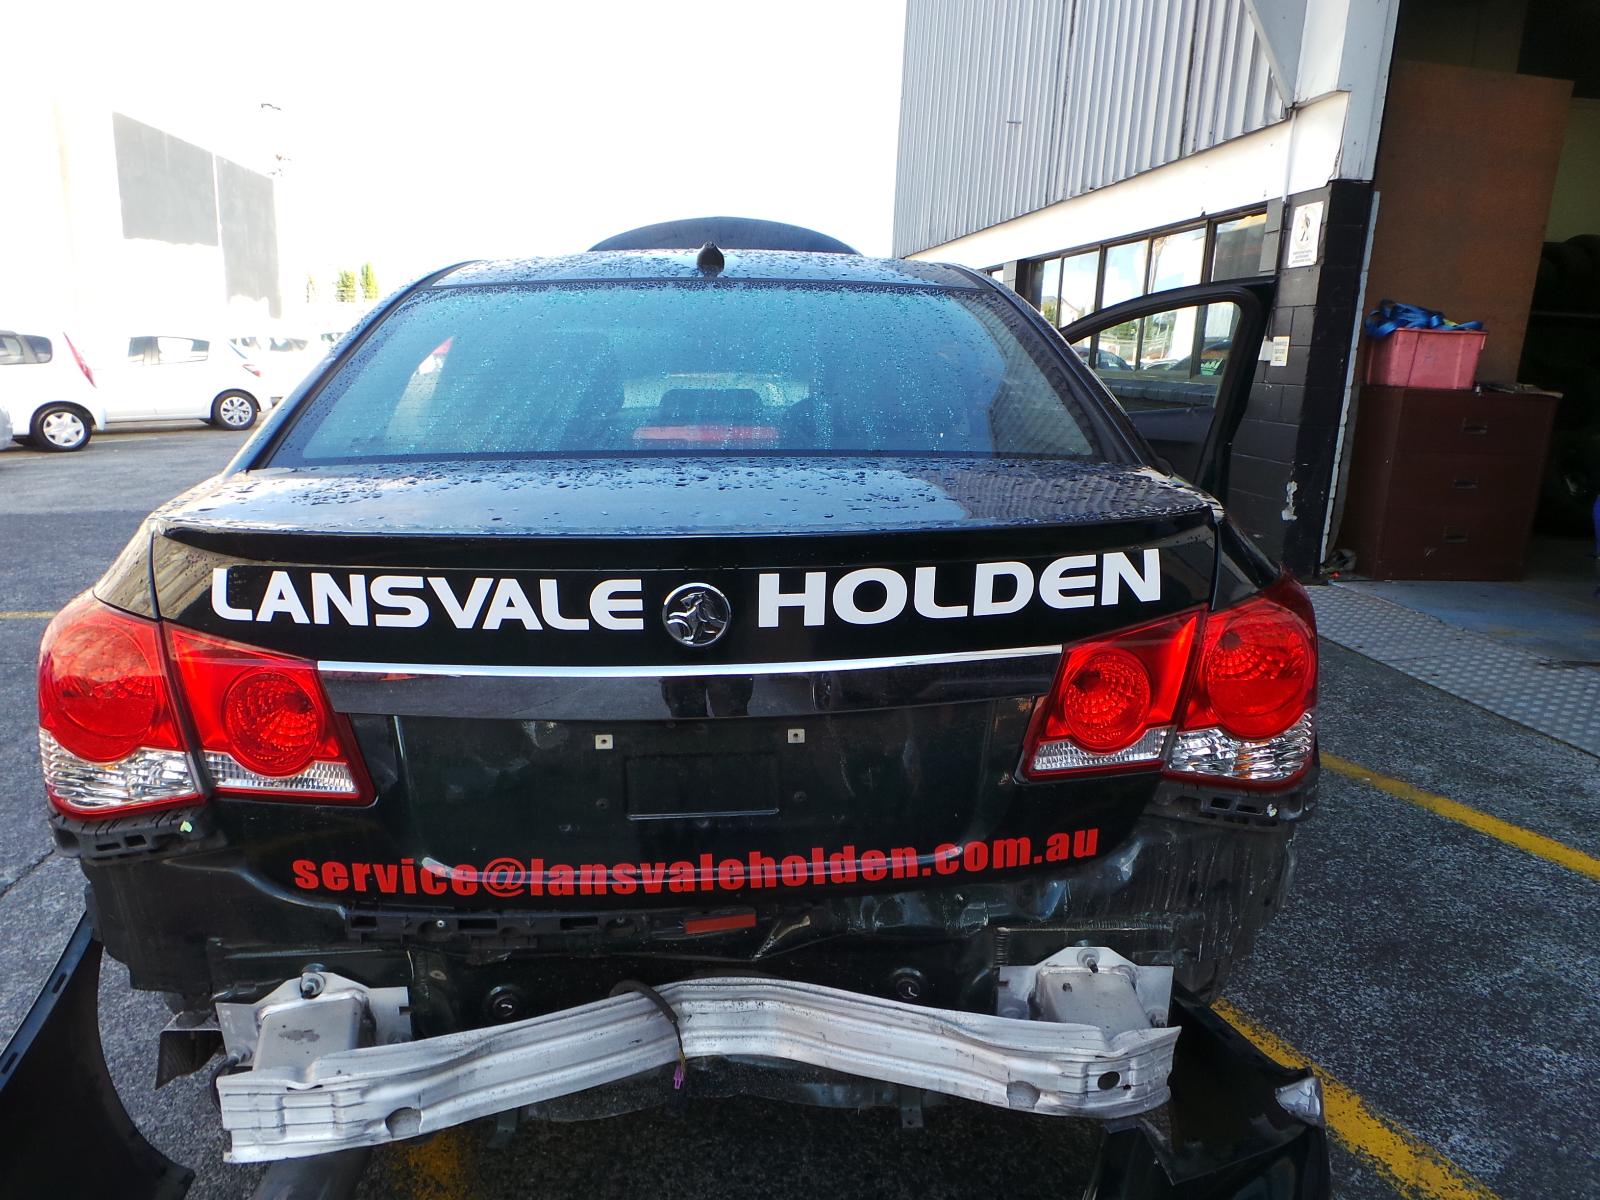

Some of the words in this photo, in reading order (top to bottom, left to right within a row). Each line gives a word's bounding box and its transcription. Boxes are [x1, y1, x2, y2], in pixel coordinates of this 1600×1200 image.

[211, 567, 644, 631] LANSVALE
[757, 548, 1162, 628] HOLDEN
[292, 828, 1099, 897] service@lansvaleholden.com.au
